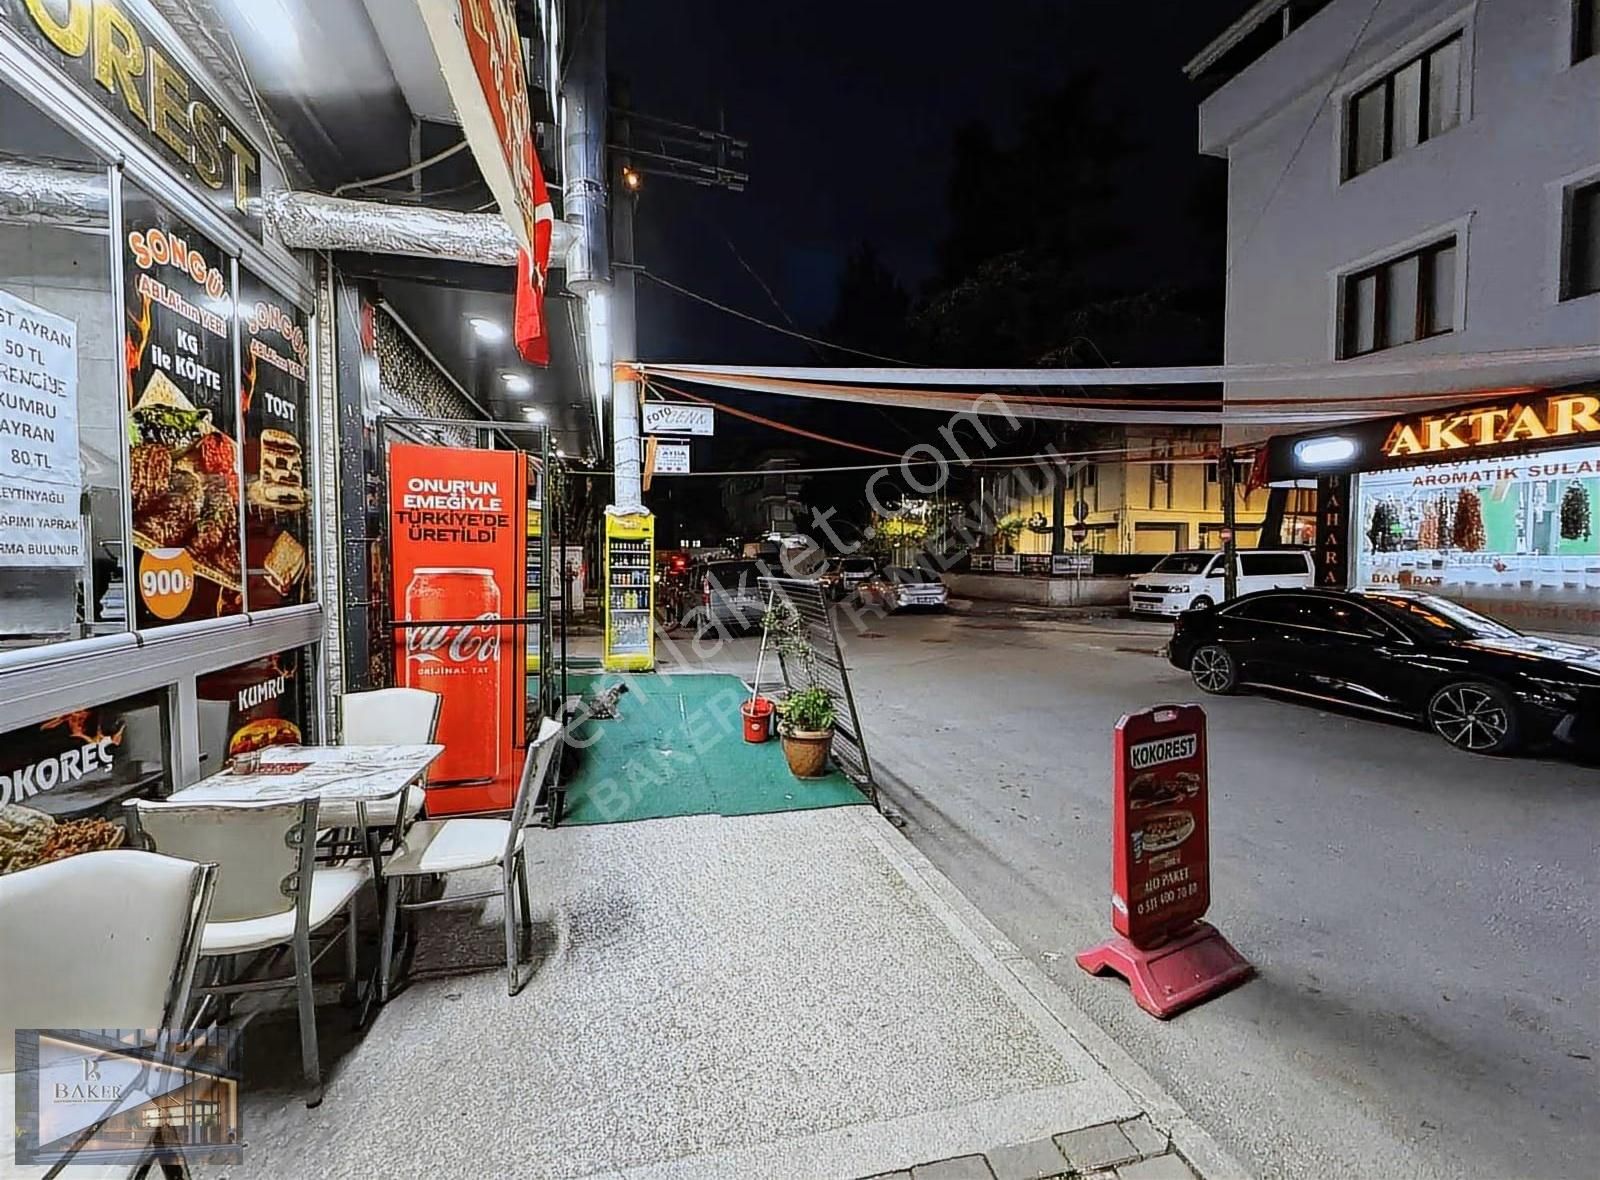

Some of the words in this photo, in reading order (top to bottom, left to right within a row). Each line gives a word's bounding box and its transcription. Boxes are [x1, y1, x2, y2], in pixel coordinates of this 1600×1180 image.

[128, 228, 230, 312] SONGÜ
[19, 317, 72, 349] AYRAN
[177, 328, 198, 355] KG
[6, 339, 24, 358] 50
[28, 346, 45, 366] TL
[175, 355, 221, 391] KÖFTE
[265, 392, 296, 422] TOST
[646, 407, 672, 424] FOTO
[0, 418, 55, 443] AYRAN
[1386, 396, 1600, 457] AKTAR
[11, 449, 31, 465] 80
[34, 452, 52, 469] TL
[408, 478, 496, 495] ONUR'UN
[1412, 465, 1518, 488] AROMATİK
[0, 486, 65, 504] EYTİNYAĞLI
[404, 492, 502, 512] EMEĞİYLE
[36, 517, 78, 530] YAPRAK
[395, 508, 509, 529] TÜRKİYE'DE
[408, 524, 497, 544] ÜRETİLDİ
[28, 544, 79, 556] BULUNUR
[1372, 573, 1444, 586] BAHRAT
[238, 676, 285, 712] KUMRU
[1131, 737, 1195, 768] KOKOREST
